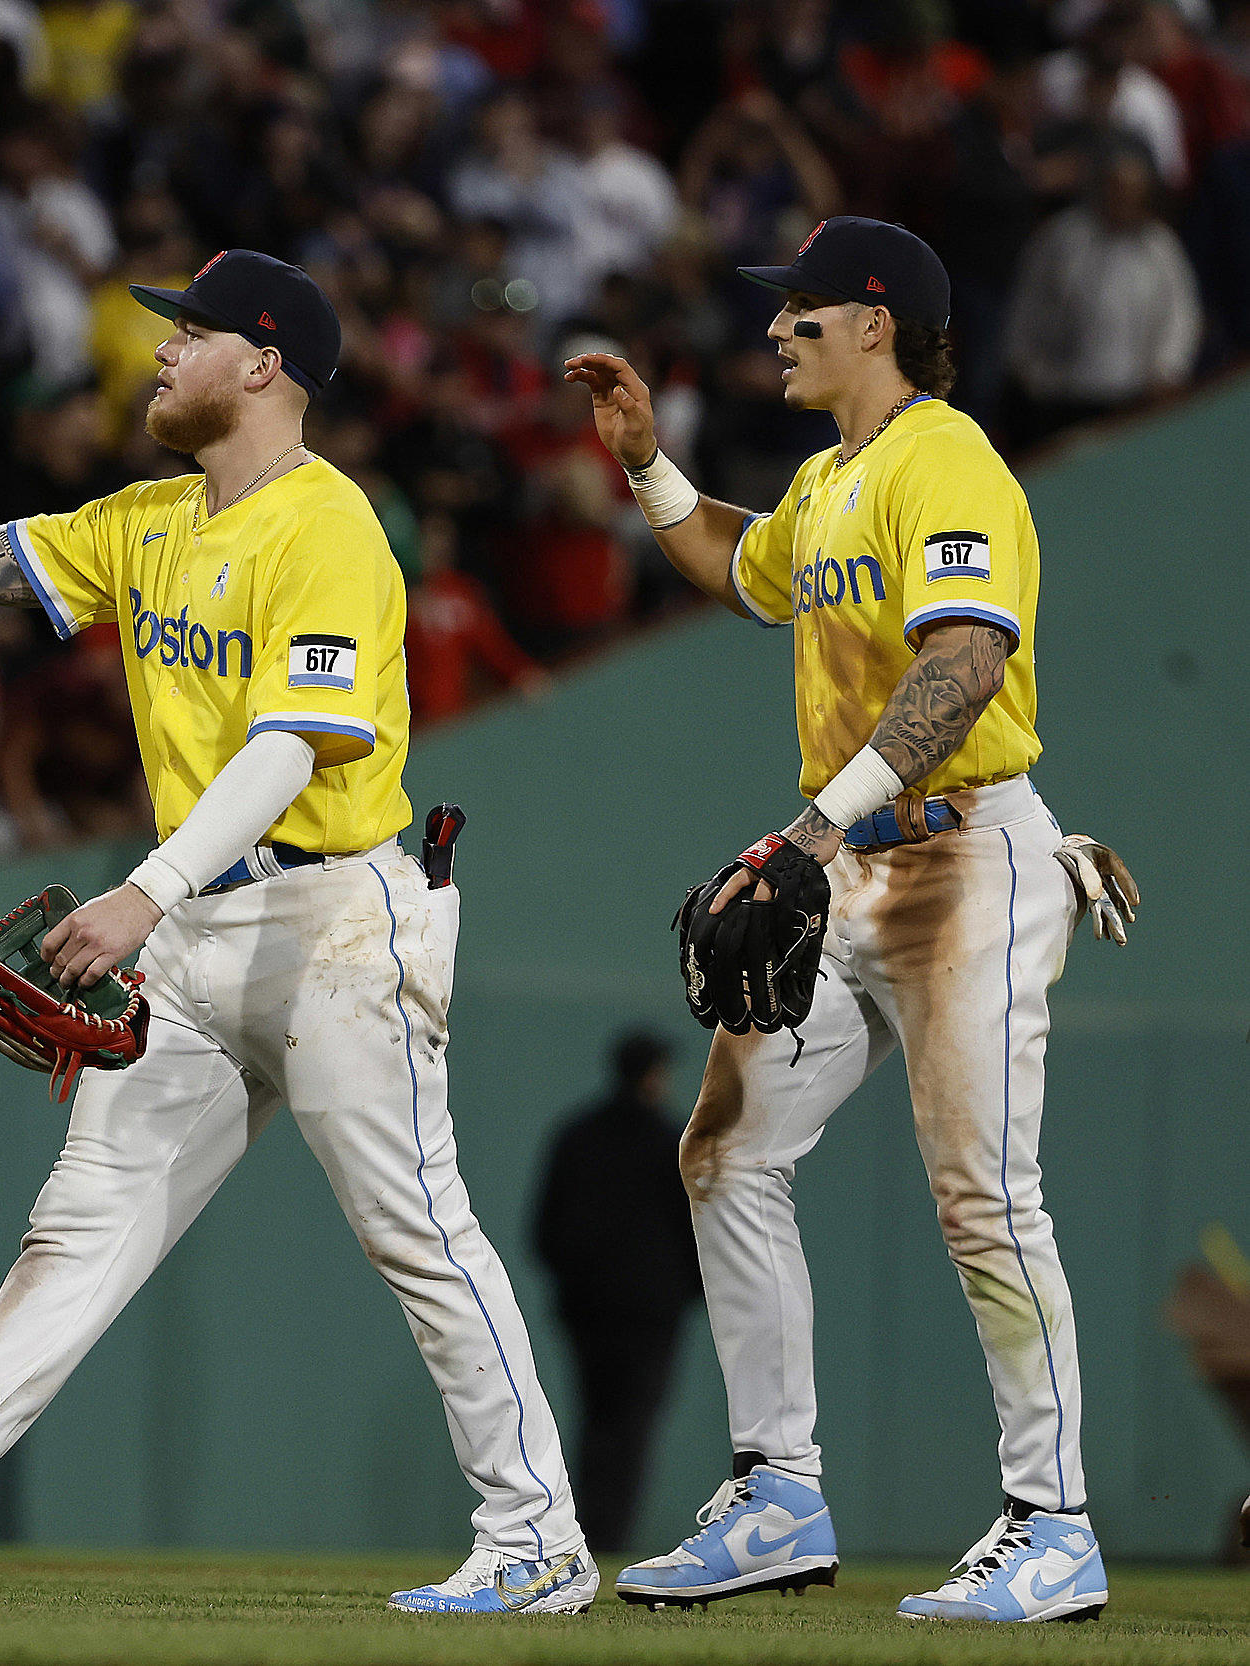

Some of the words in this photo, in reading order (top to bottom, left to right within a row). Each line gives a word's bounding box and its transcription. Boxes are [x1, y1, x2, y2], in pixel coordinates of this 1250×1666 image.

[941, 543, 973, 566] 617
[791, 547, 886, 619] oston
[306, 647, 340, 674] 617
